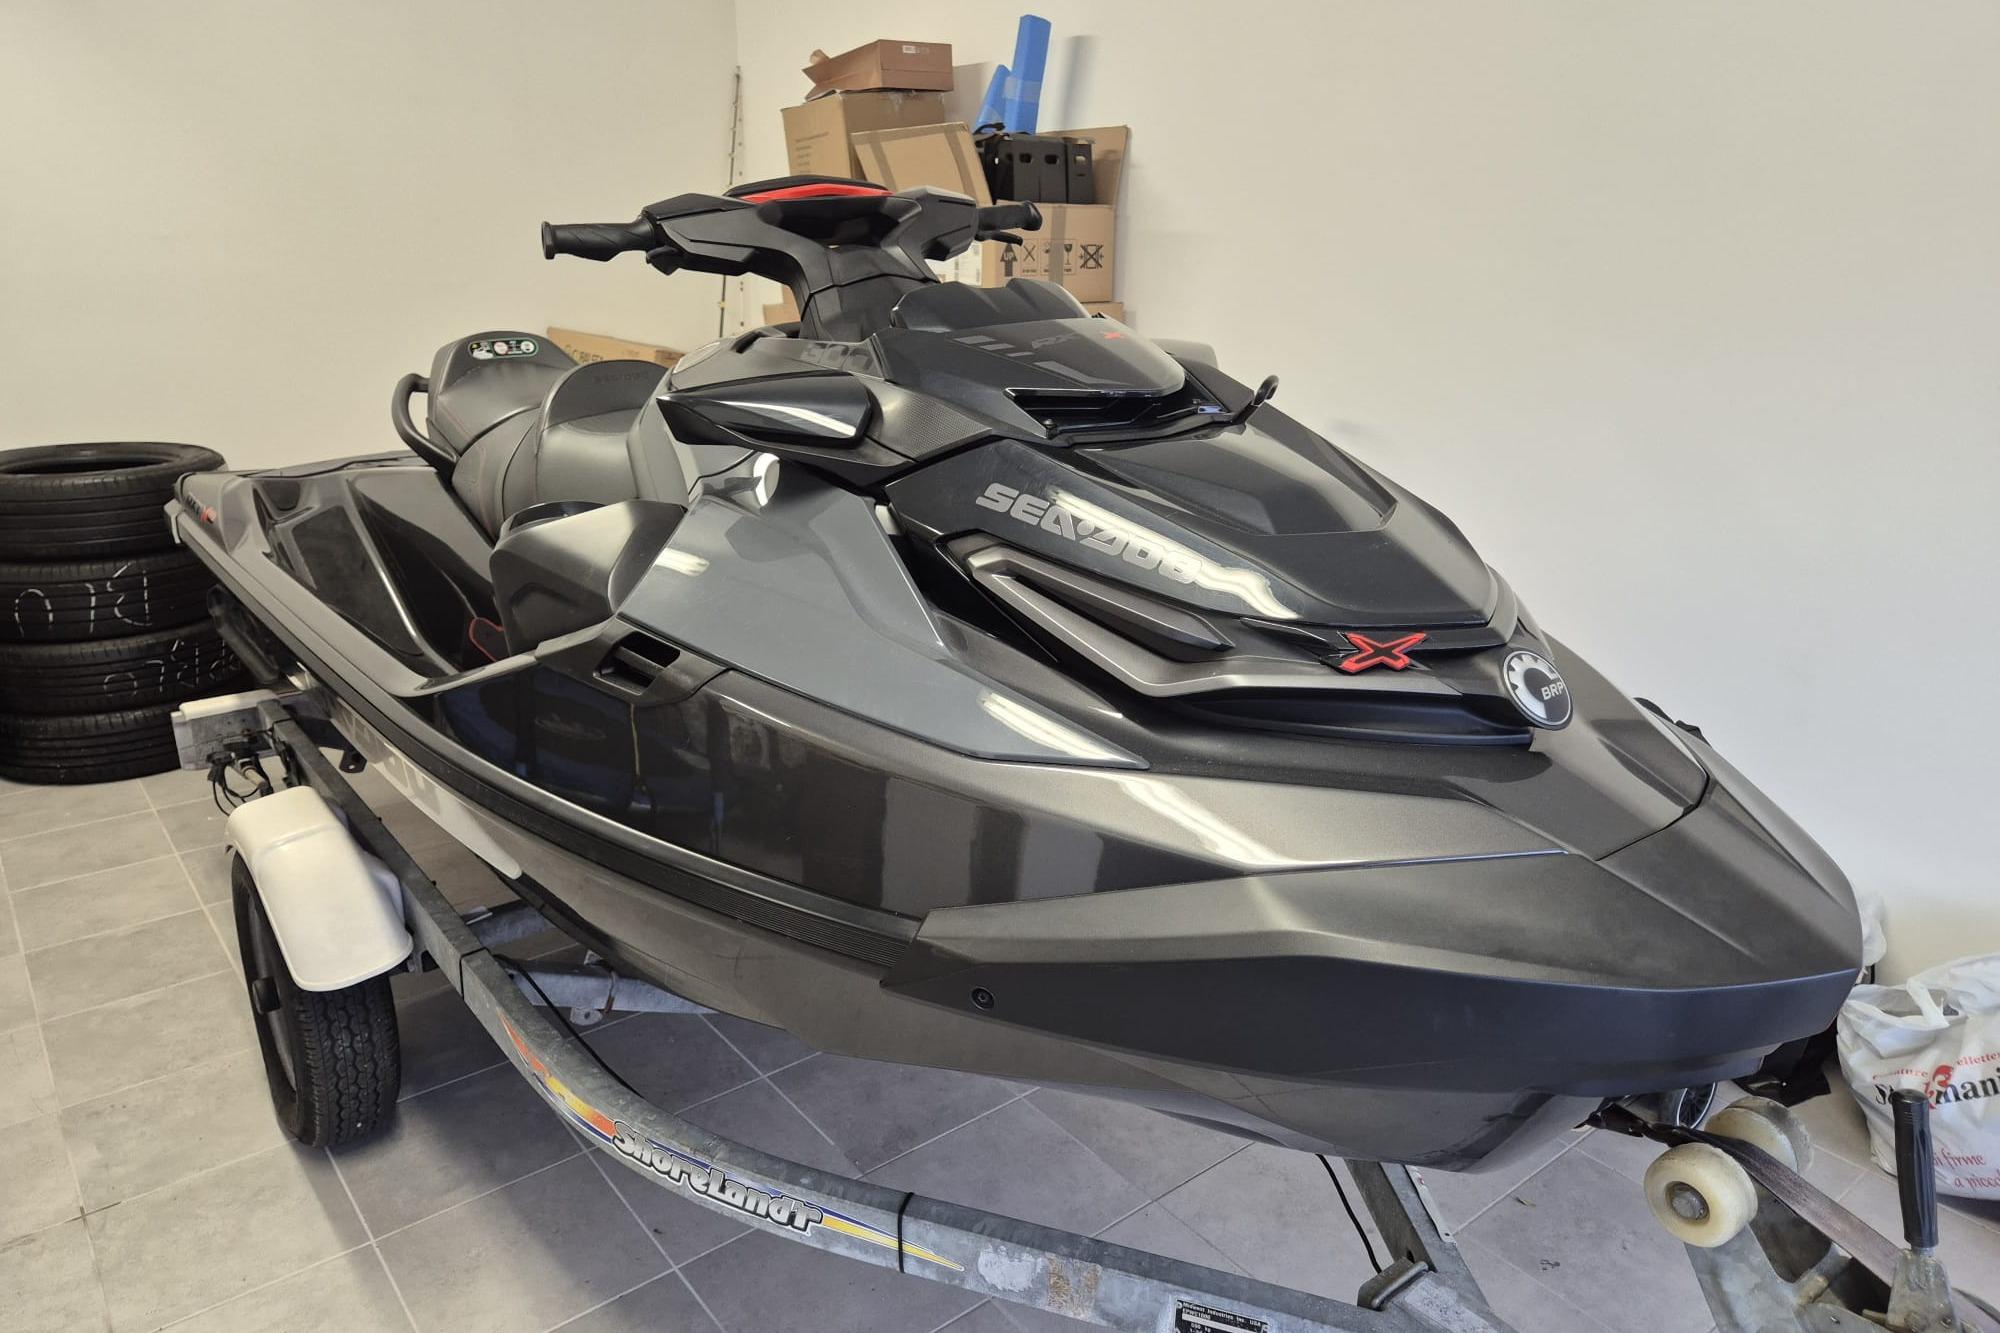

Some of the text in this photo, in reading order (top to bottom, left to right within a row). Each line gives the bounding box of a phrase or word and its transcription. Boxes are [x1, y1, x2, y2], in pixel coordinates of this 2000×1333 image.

[1003, 252, 1014, 261] UP
[1541, 682, 1564, 701] BRP
[1940, 1148, 1986, 1169] firme
[1954, 1177, 1965, 1188] a
